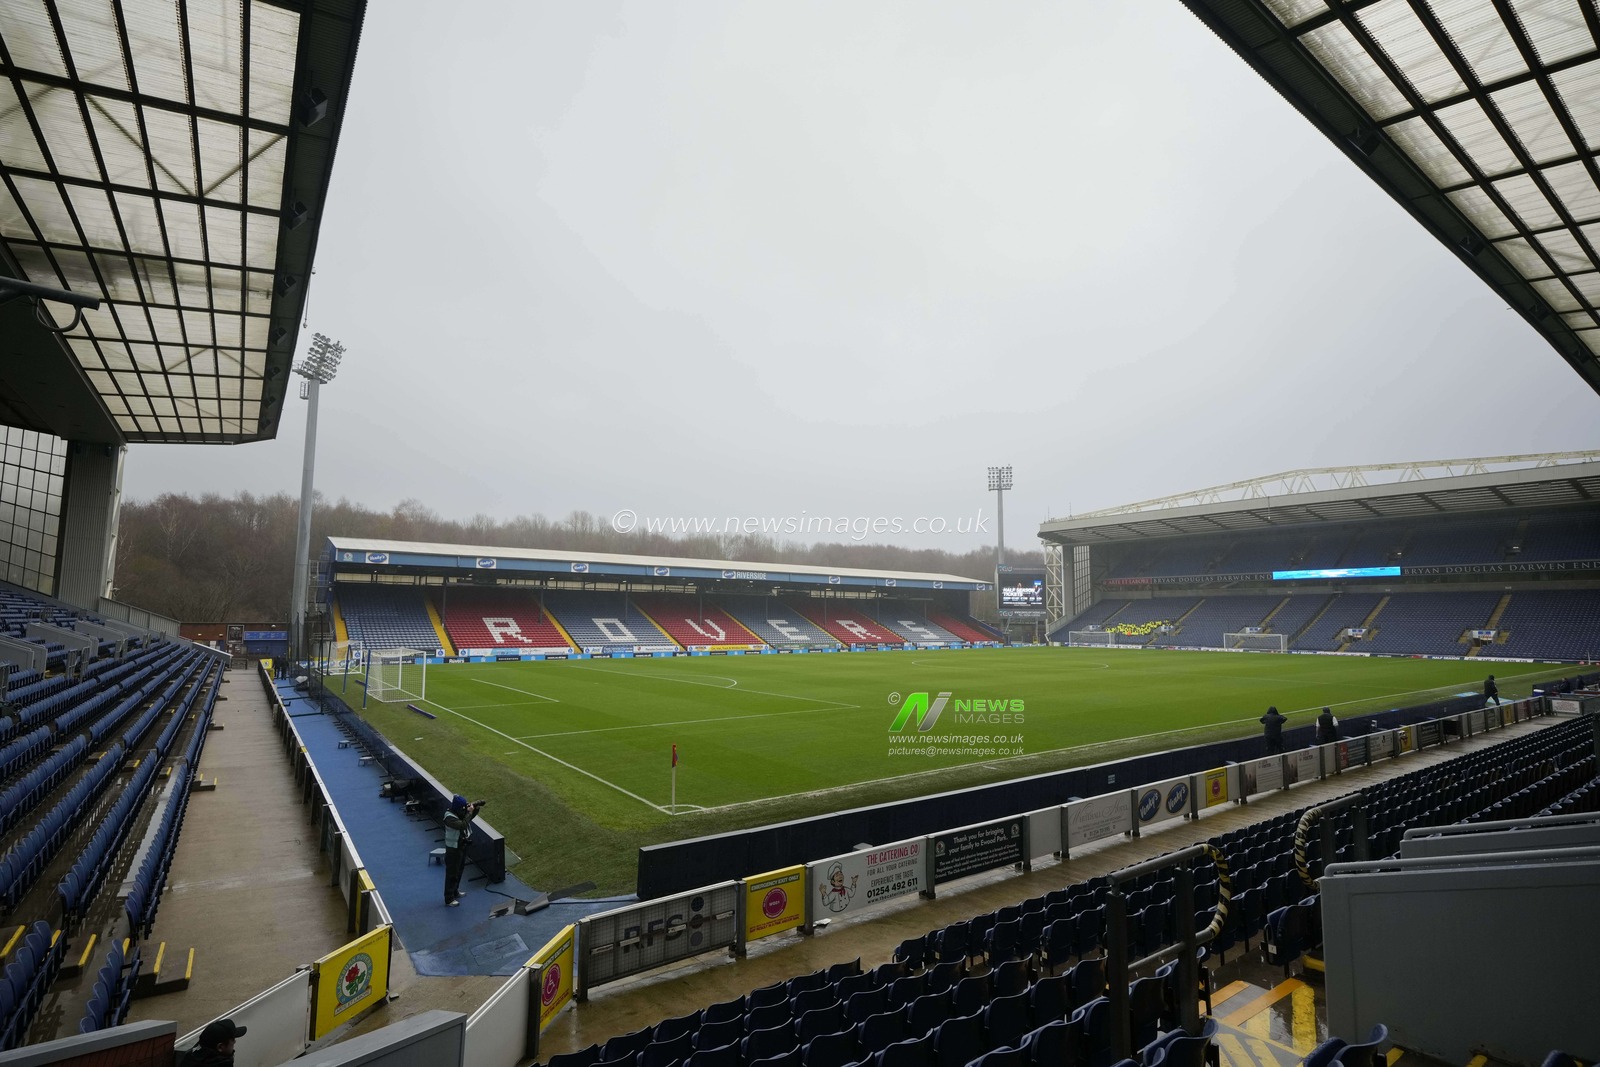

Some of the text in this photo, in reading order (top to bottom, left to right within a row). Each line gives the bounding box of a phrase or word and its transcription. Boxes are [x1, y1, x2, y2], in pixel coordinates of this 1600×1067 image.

[736, 571, 767, 580] RIVERSIDE
[1403, 561, 1600, 576] BRYAN DOUGLAS DARWEN END
[1153, 576, 1174, 584] BRYAN
[1178, 575, 1214, 583] DOUGLAS
[1217, 574, 1252, 582] DARWEN
[1140, 792, 1159, 818] Venky's
[1168, 785, 1186, 811] Venky's
[953, 835, 968, 844] Thank
[968, 834, 977, 842] you
[985, 827, 1005, 837] bringing
[948, 846, 960, 856] your
[960, 841, 975, 851] family
[980, 837, 996, 846] Ewood
[996, 834, 1008, 842] Park.
[866, 844, 919, 866] THE CATERING CO
[867, 869, 875, 877] FOR
[886, 863, 897, 871] YOUR
[898, 858, 918, 868] CATERING
[751, 874, 800, 891] EMERGENCY EXIT ONLY
[871, 869, 914, 887] EXPERIENCE THE TASTE
[867, 877, 918, 898] 01254 492 611
